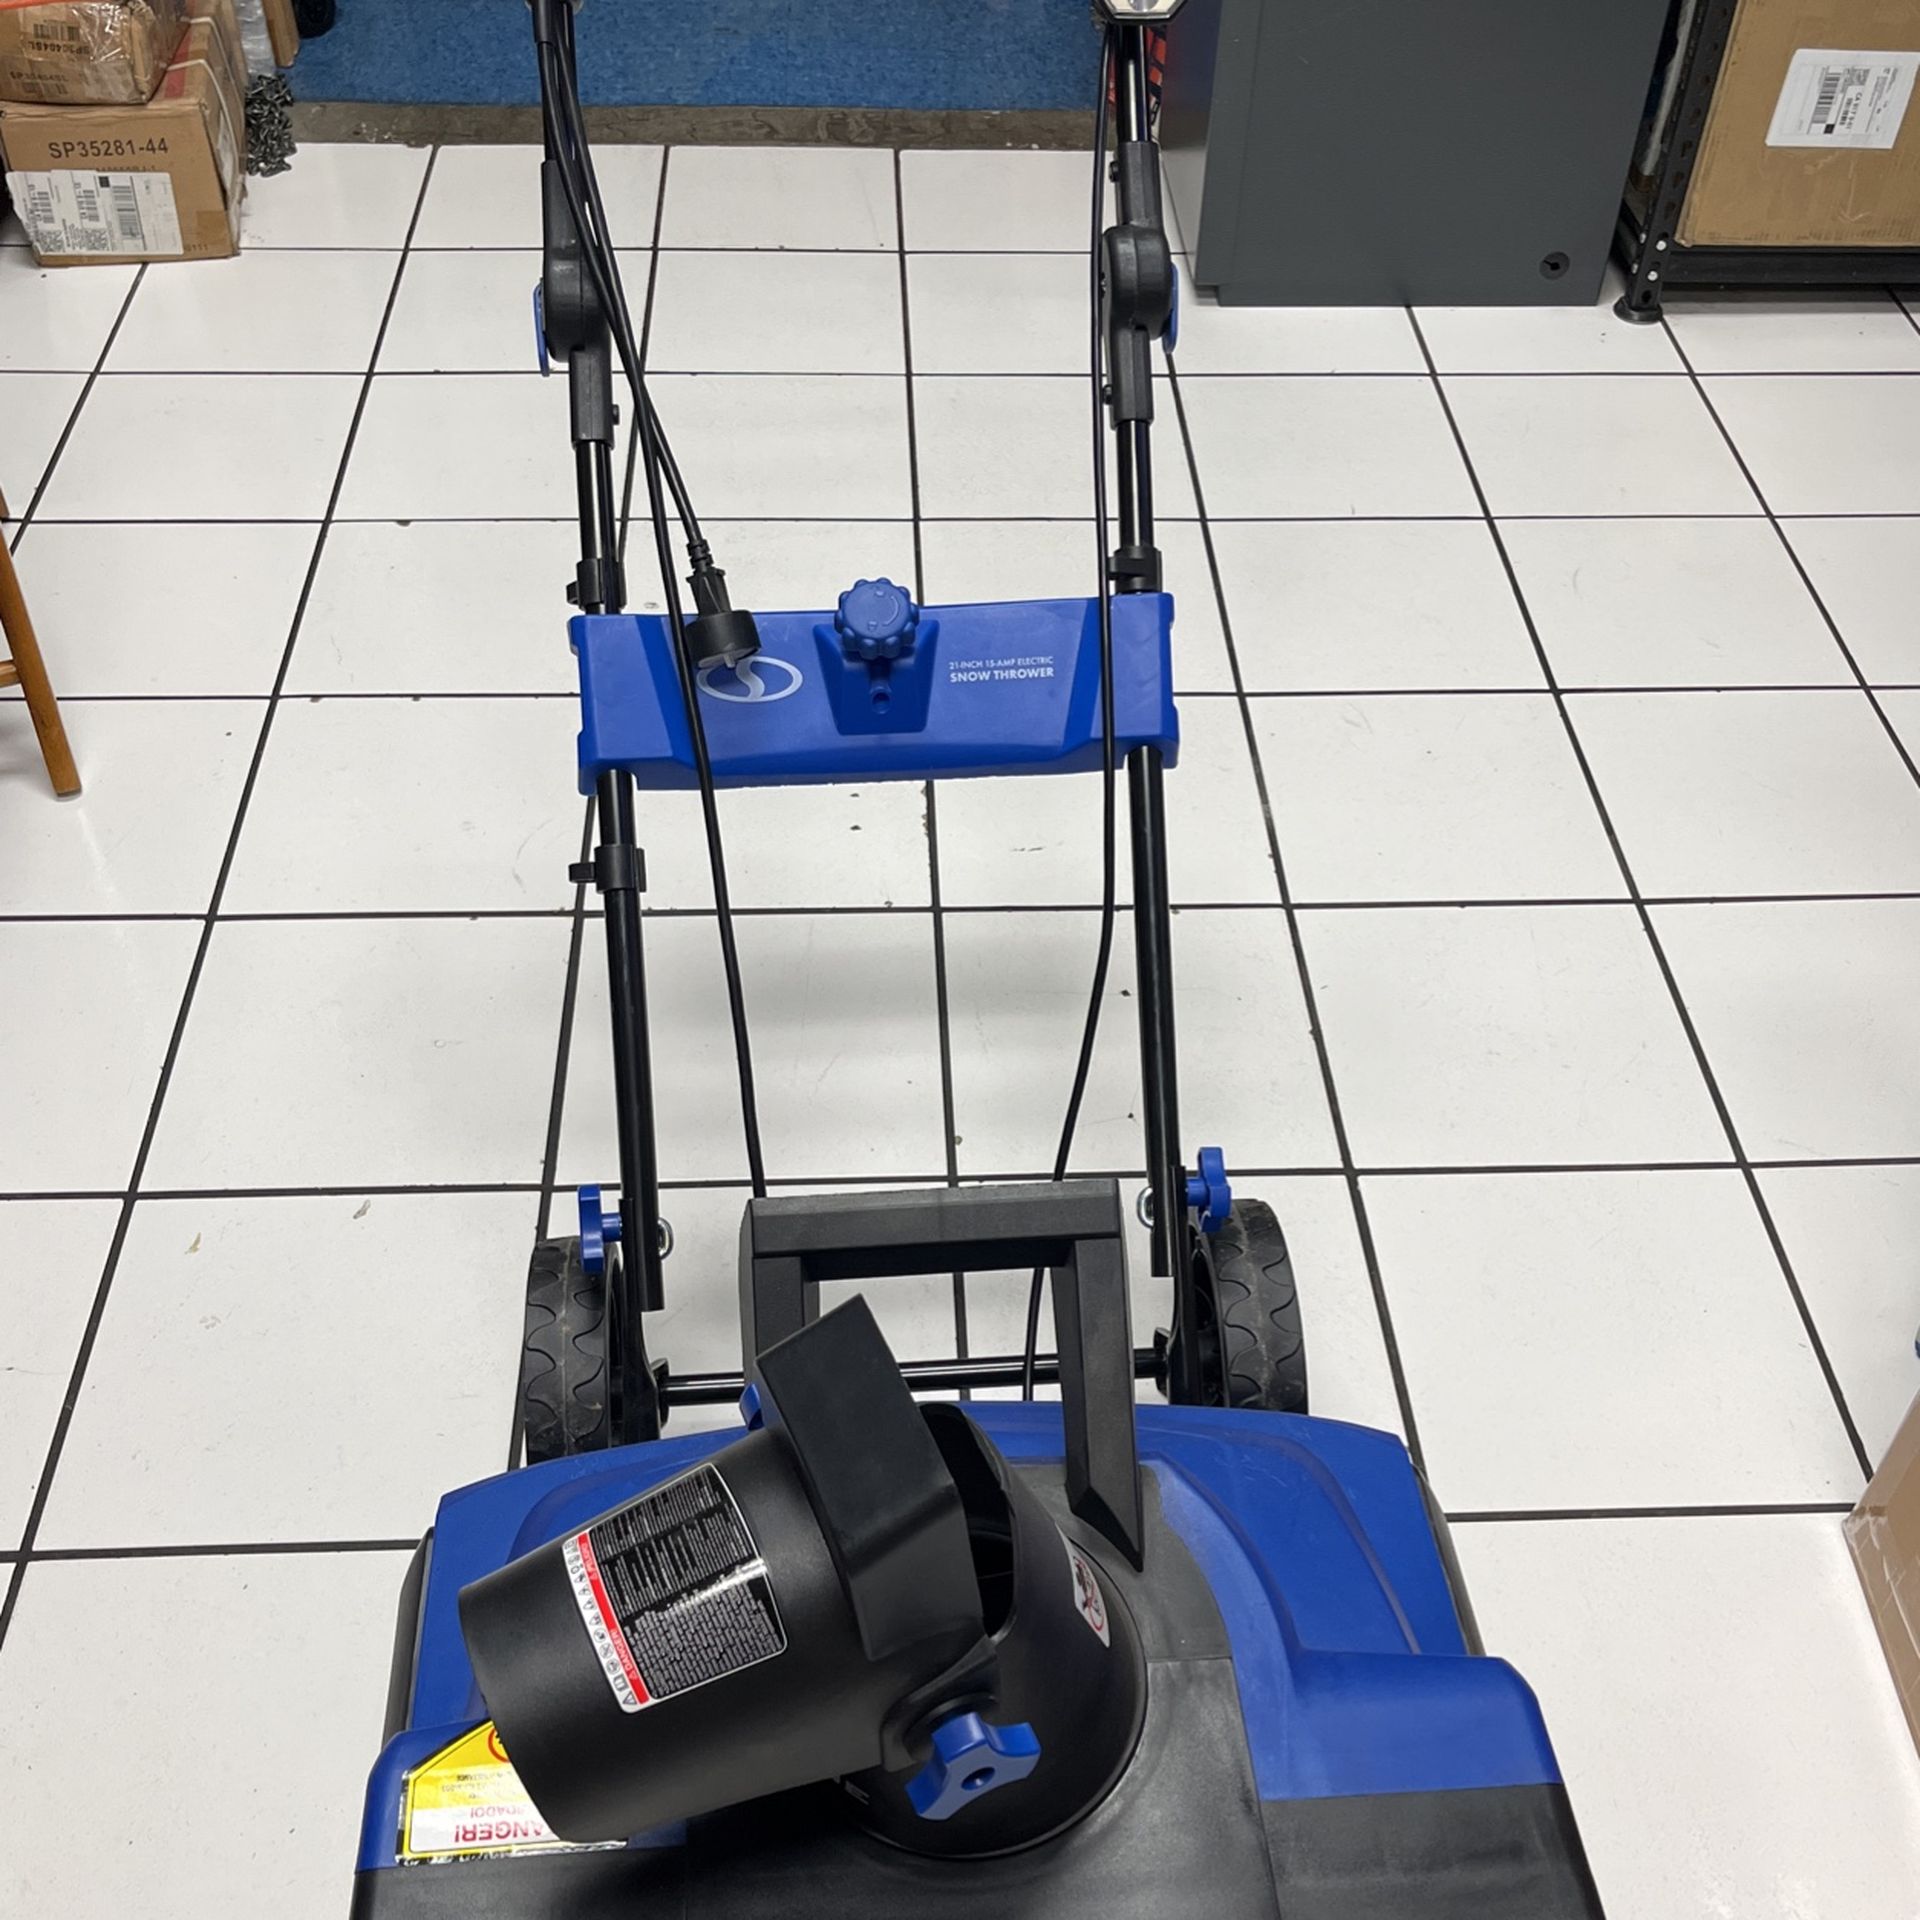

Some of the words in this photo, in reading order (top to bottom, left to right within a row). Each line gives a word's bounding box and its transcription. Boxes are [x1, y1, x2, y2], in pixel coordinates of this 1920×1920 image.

[48, 137, 168, 159] SP35281-44
[949, 660, 983, 670] 21-INCH
[986, 657, 1016, 668] 15-AMP
[1017, 655, 1054, 666] ELECTRIC
[950, 670, 991, 683] SNOW
[993, 667, 1055, 680] THROWER
[610, 1628, 635, 1672] DANGER
[454, 1821, 544, 1843] ANGER!
